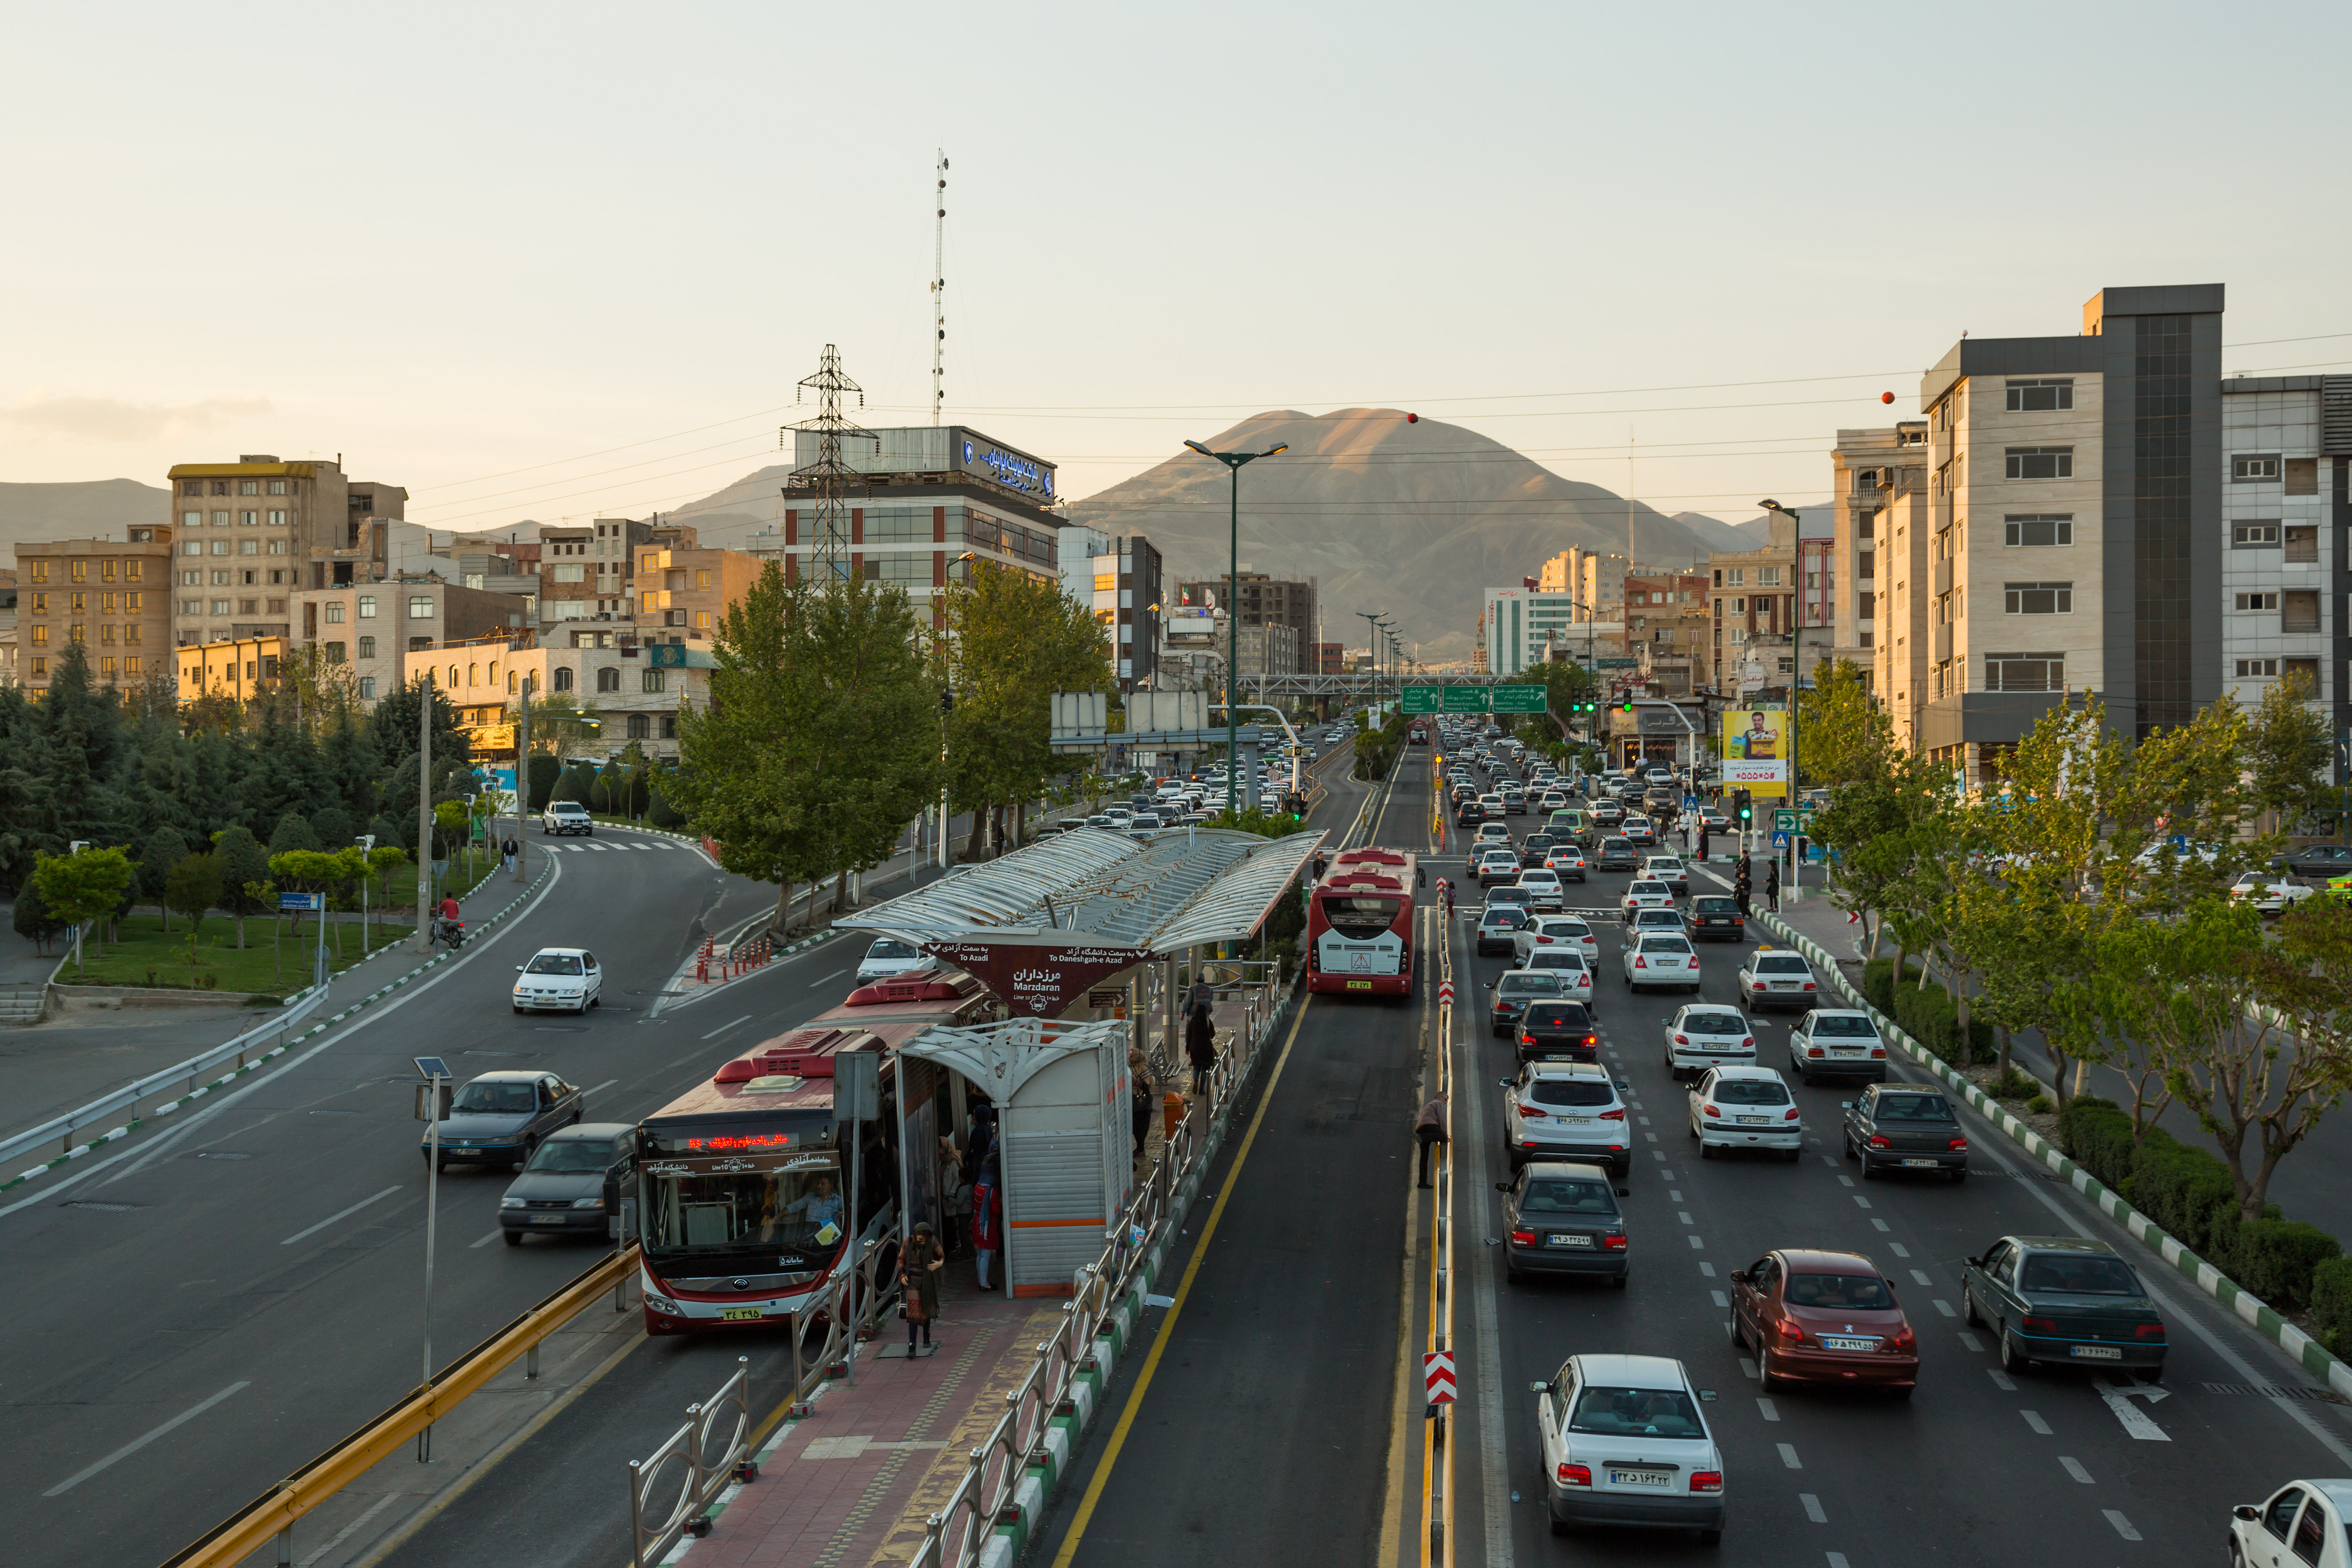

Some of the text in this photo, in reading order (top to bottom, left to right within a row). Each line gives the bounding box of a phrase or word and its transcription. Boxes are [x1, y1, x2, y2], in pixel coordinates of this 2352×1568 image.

[989, 448, 1007, 472] ایرانیان
[1007, 454, 1023, 478] لیزینگ
[1023, 462, 1038, 483] شرکت
[942, 944, 961, 952] آزادی
[1067, 947, 1080, 956] آزاد
[1059, 955, 1104, 964] Daneshgah-e
[1013, 968, 1061, 982] مرزداران
[1013, 982, 1060, 992] Marzdaran
[787, 1154, 810, 1165] آزادی
[647, 1162, 664, 1173] آزاد
